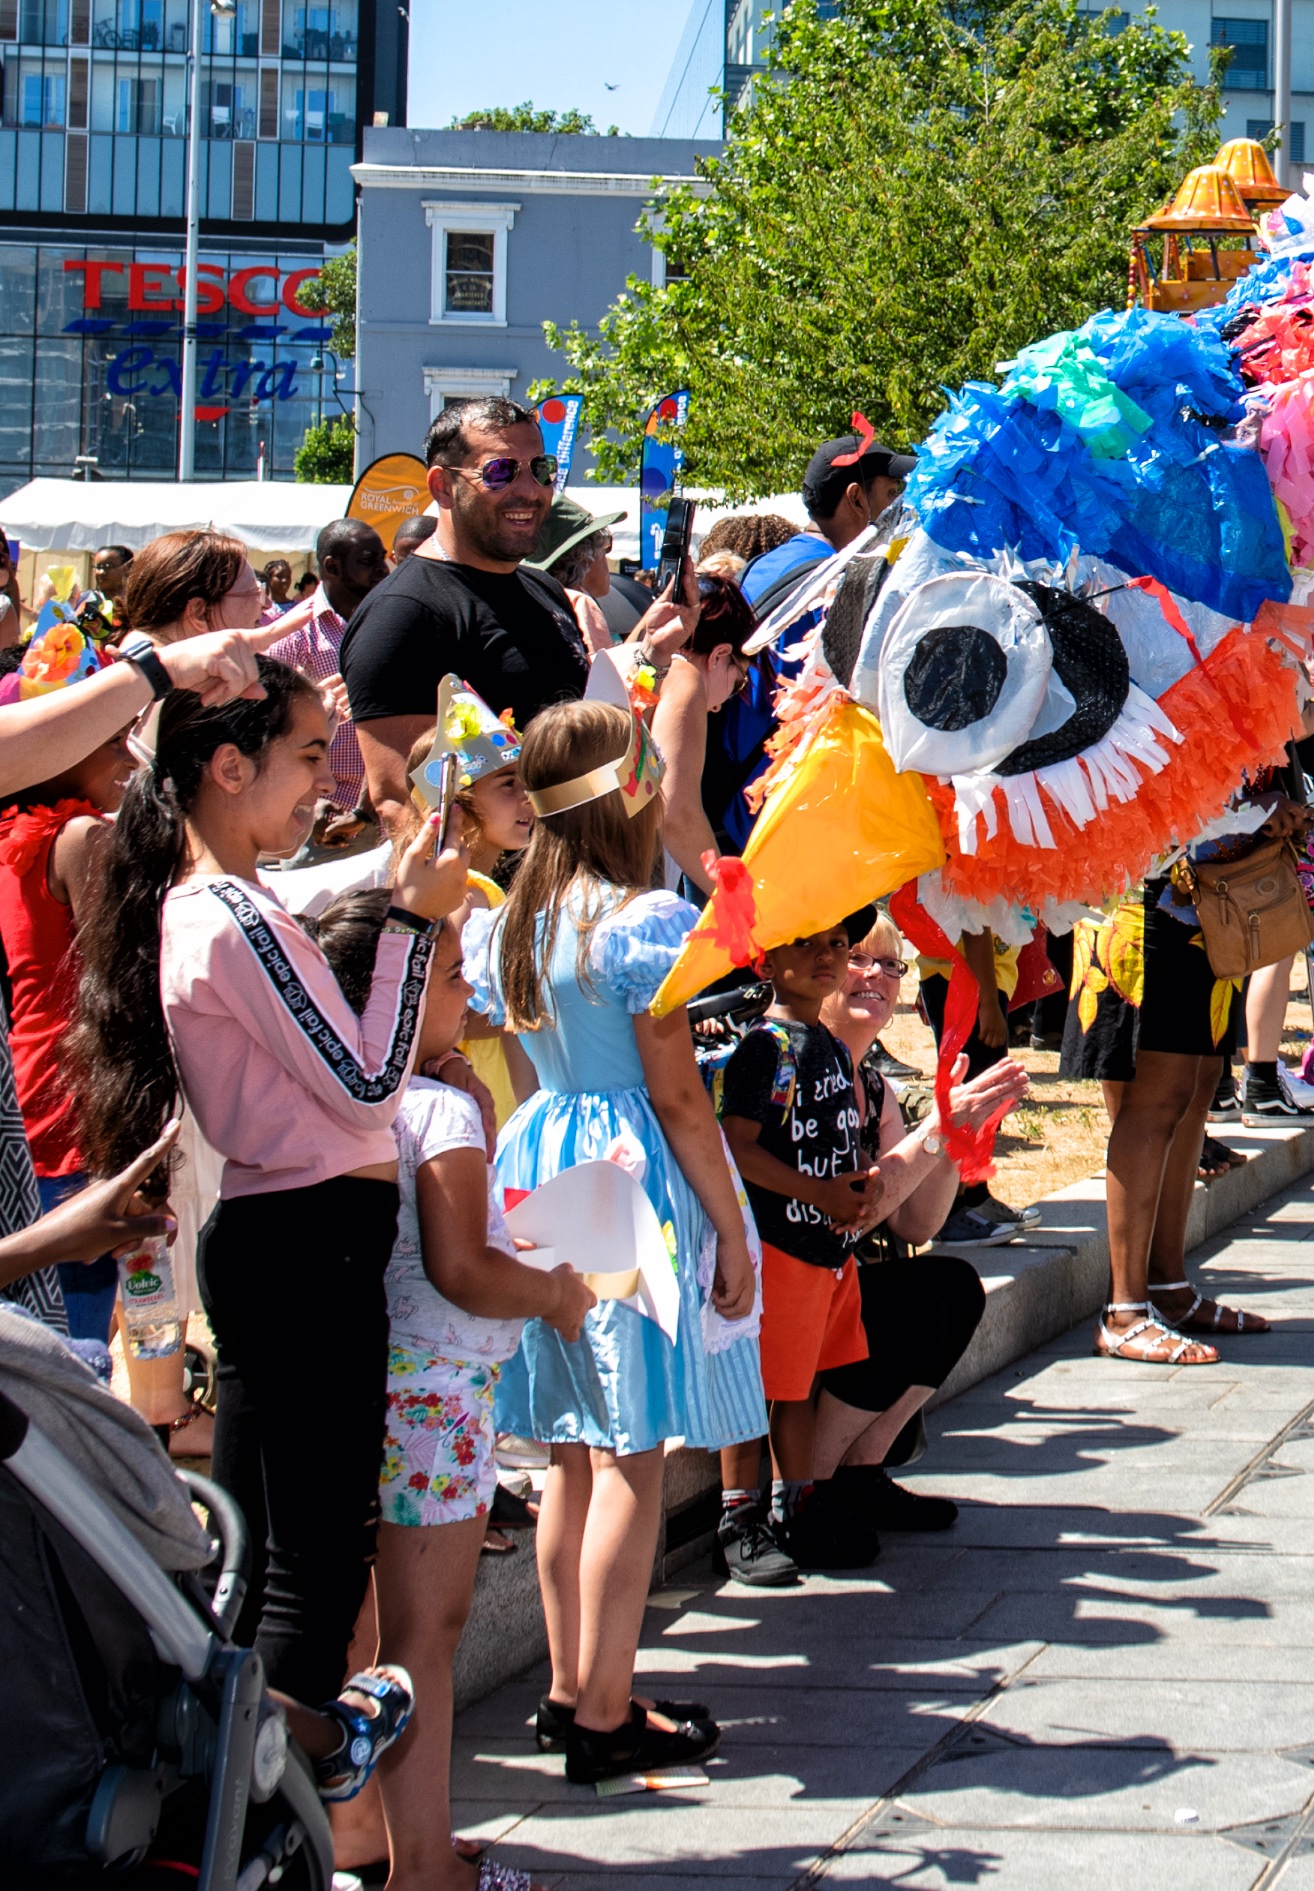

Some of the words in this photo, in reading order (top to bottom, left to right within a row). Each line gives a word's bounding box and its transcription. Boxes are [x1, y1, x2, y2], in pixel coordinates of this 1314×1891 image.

[63, 260, 338, 318] TESCO
[106, 346, 298, 400] extra
[557, 400, 579, 464] Difference
[360, 501, 419, 515] GREENWICH
[361, 493, 391, 504] ROYAL
[248, 926, 275, 953] fail
[266, 949, 291, 982] epic
[412, 954, 427, 978] fail
[297, 1008, 324, 1034] fail
[401, 1008, 414, 1041] epic
[318, 1029, 343, 1060] epic
[392, 1041, 410, 1068] fail
[791, 1106, 818, 1141] be
[127, 1278, 160, 1291] Volvic
